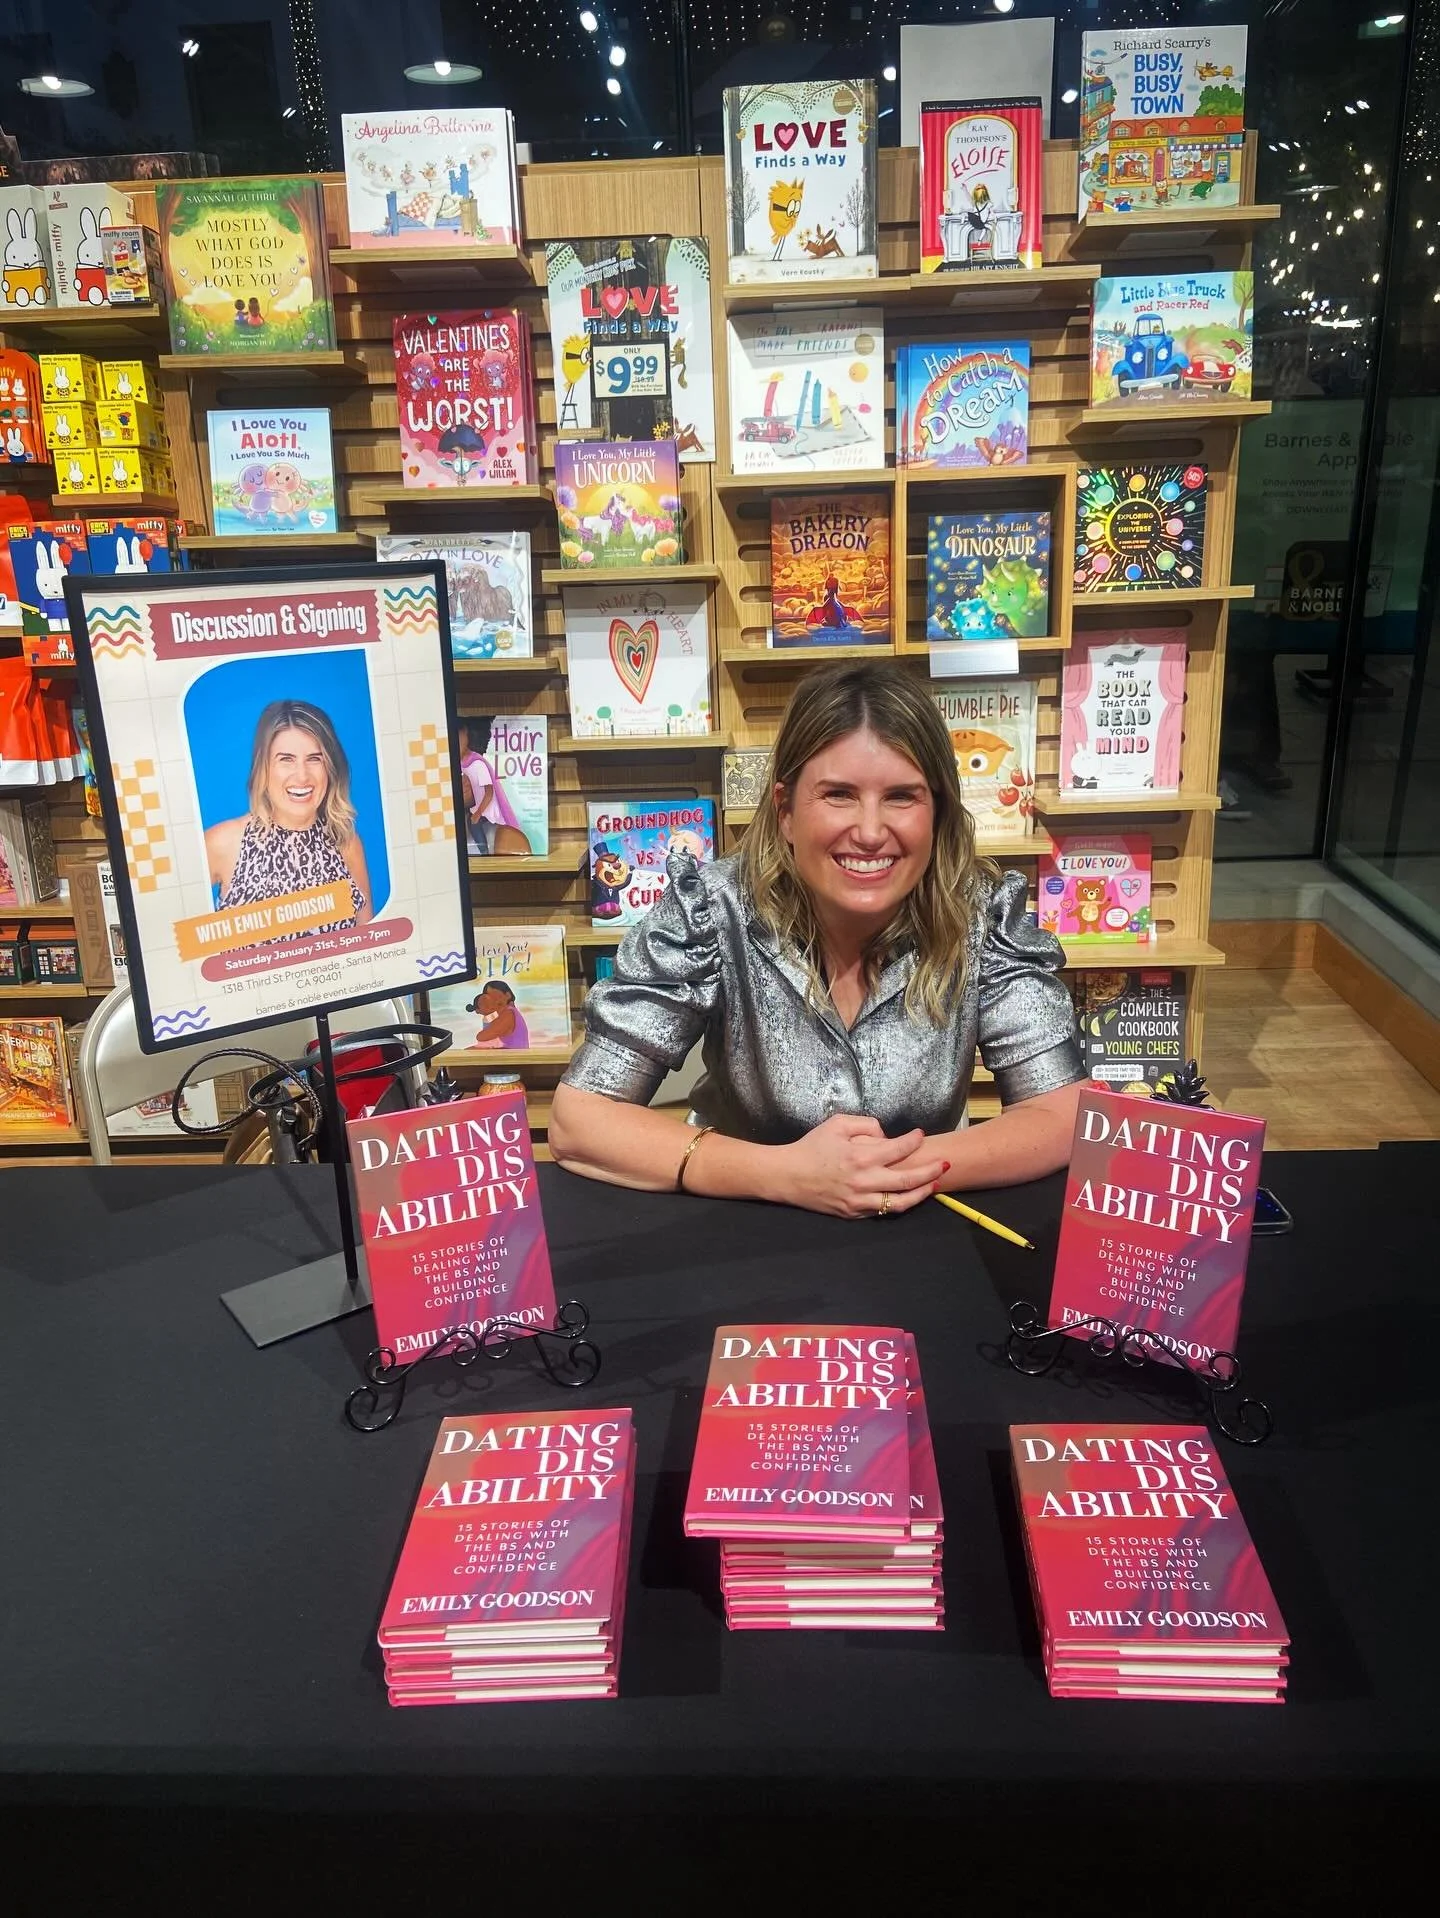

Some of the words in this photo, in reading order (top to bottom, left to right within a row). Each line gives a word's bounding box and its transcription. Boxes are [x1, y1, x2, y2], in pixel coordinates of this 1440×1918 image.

[1114, 40, 1161, 50] Richard
[1165, 37, 1211, 49] Scarry's
[1134, 53, 1183, 73] BUSY,
[1134, 74, 1182, 93] BUSY
[1131, 93, 1184, 115] TOWN
[355, 121, 421, 143] Angelina
[754, 119, 847, 151] LOVE
[955, 135, 1007, 144] THOMPSON'S
[755, 156, 795, 169] Finds
[802, 156, 809, 166] a
[815, 153, 846, 167] Way
[951, 146, 1010, 179] ELOISE
[207, 217, 270, 233] MOSTLY
[196, 237, 244, 252] WHAT
[250, 237, 284, 249] GOD
[211, 256, 252, 269] DOES
[259, 256, 273, 267] IS
[204, 273, 246, 288] LOVE
[251, 273, 282, 286] YOU
[1121, 286, 1154, 303] Little
[1187, 280, 1227, 299] Truck
[580, 285, 680, 319] LOVE
[1134, 302, 1152, 313] and
[1156, 301, 1188, 311] Racer
[1189, 299, 1209, 310] Red
[583, 320, 627, 335] Finds
[649, 319, 679, 334] Way
[402, 324, 510, 355] VALENTINES
[444, 358, 470, 372] ARE
[922, 348, 962, 382] How
[445, 379, 470, 392] THE
[926, 389, 943, 407] to
[947, 351, 999, 397] Catch
[1002, 347, 1014, 364] a
[232, 421, 237, 431] I
[241, 419, 276, 430] Love
[280, 418, 307, 431] You
[407, 397, 514, 432] WORST!
[1264, 433, 1332, 447] Barnes
[1338, 432, 1351, 447] &
[288, 452, 309, 460] Much
[493, 459, 512, 468] ALEX
[578, 450, 596, 460] Love
[598, 449, 616, 459] You,
[618, 449, 632, 460] My
[634, 448, 656, 457] Little
[1317, 453, 1357, 470] App
[489, 469, 517, 478] WILLAN
[574, 460, 656, 488] UNICORN
[818, 503, 842, 513] THE
[790, 515, 872, 537] BAKERY
[956, 524, 974, 534] Love
[976, 524, 993, 534] You,
[995, 523, 1009, 535] My
[1010, 522, 1033, 532] Little
[790, 533, 870, 555] DRAGON
[945, 534, 1036, 559] DINOSAUR
[462, 548, 503, 568] LOVE
[170, 608, 278, 644] Discussion
[280, 605, 297, 635] &
[298, 601, 367, 638] Signing
[596, 601, 610, 614] IN
[614, 593, 634, 608] MY
[665, 611, 693, 656] HEART
[1098, 679, 1151, 699] BOOK
[938, 695, 993, 721] HUMBLE
[999, 694, 1020, 719] PIE
[1101, 700, 1125, 708] THAT
[1129, 699, 1147, 707] CAN
[1096, 708, 1151, 727] READ
[493, 724, 543, 753] Hair
[1110, 728, 1136, 736] YOUR
[1095, 736, 1150, 754] MIND
[494, 753, 542, 780] Love
[596, 808, 704, 834] GROUNDHOG
[1061, 858, 1069, 869] I
[1071, 858, 1097, 869] LOVE
[1100, 857, 1127, 869] YOU!
[196, 923, 232, 944] WITH
[235, 909, 273, 933] EMILY
[276, 893, 336, 925] GOODSON
[225, 953, 273, 971] Saturday
[273, 943, 314, 962] January
[315, 939, 338, 952] 31st,
[339, 934, 362, 948] 5pm
[368, 927, 391, 942] 7pm
[222, 982, 244, 995] 1318
[245, 977, 271, 990] Third
[273, 975, 283, 986] St
[285, 960, 340, 982] Promenade
[346, 955, 372, 968] Santa
[373, 948, 407, 963] Monica
[296, 979, 312, 990] CA
[312, 972, 342, 987] 90401
[256, 1002, 286, 1016] barnes
[288, 1000, 296, 1008] &
[297, 993, 321, 1007] noble
[323, 987, 348, 1000] event
[349, 979, 385, 995] calendar
[1150, 988, 1163, 998] THE
[1120, 1002, 1180, 1017] COMPLETE
[1118, 1021, 1179, 1036] COOKBOOK
[30, 1042, 49, 1053] DAY
[1105, 1041, 1142, 1055] YOUNG
[1147, 1041, 1180, 1055] CHEFS
[25, 1053, 52, 1067] READ
[357, 1111, 523, 1171] DATING
[1079, 1109, 1251, 1173] DATING
[455, 1144, 526, 1188] DIS
[1165, 1162, 1244, 1209] DIS
[372, 1177, 531, 1239] ABILITY
[1071, 1178, 1245, 1244] ABILITY
[719, 1336, 898, 1361] DATING
[816, 1360, 895, 1385] DIS
[711, 1383, 899, 1411] ABILITY
[747, 1432, 814, 1442] DEALING
[821, 1434, 860, 1443] WITH
[749, 1423, 764, 1431] 15
[770, 1423, 833, 1433] STORIES
[840, 1425, 860, 1434] OF
[438, 1422, 621, 1456] DATING
[758, 1442, 785, 1451] THE
[792, 1443, 810, 1452] BS
[815, 1443, 848, 1453] AND
[764, 1452, 840, 1462] BUILDING
[1020, 1438, 1211, 1464] DATING
[534, 1448, 615, 1475] DIS
[750, 1462, 853, 1473] CONFIDENCE
[1130, 1464, 1218, 1492] DIS
[423, 1474, 617, 1509] ABILITY
[703, 1487, 778, 1503] EMILY
[780, 1489, 894, 1507] GOODSON
[1037, 1490, 1229, 1521] ABILITY
[400, 1594, 479, 1615] EMILY
[479, 1589, 595, 1609] GOODSON
[1066, 1609, 1143, 1627] EMILY
[1147, 1610, 1268, 1629] GOODSON
